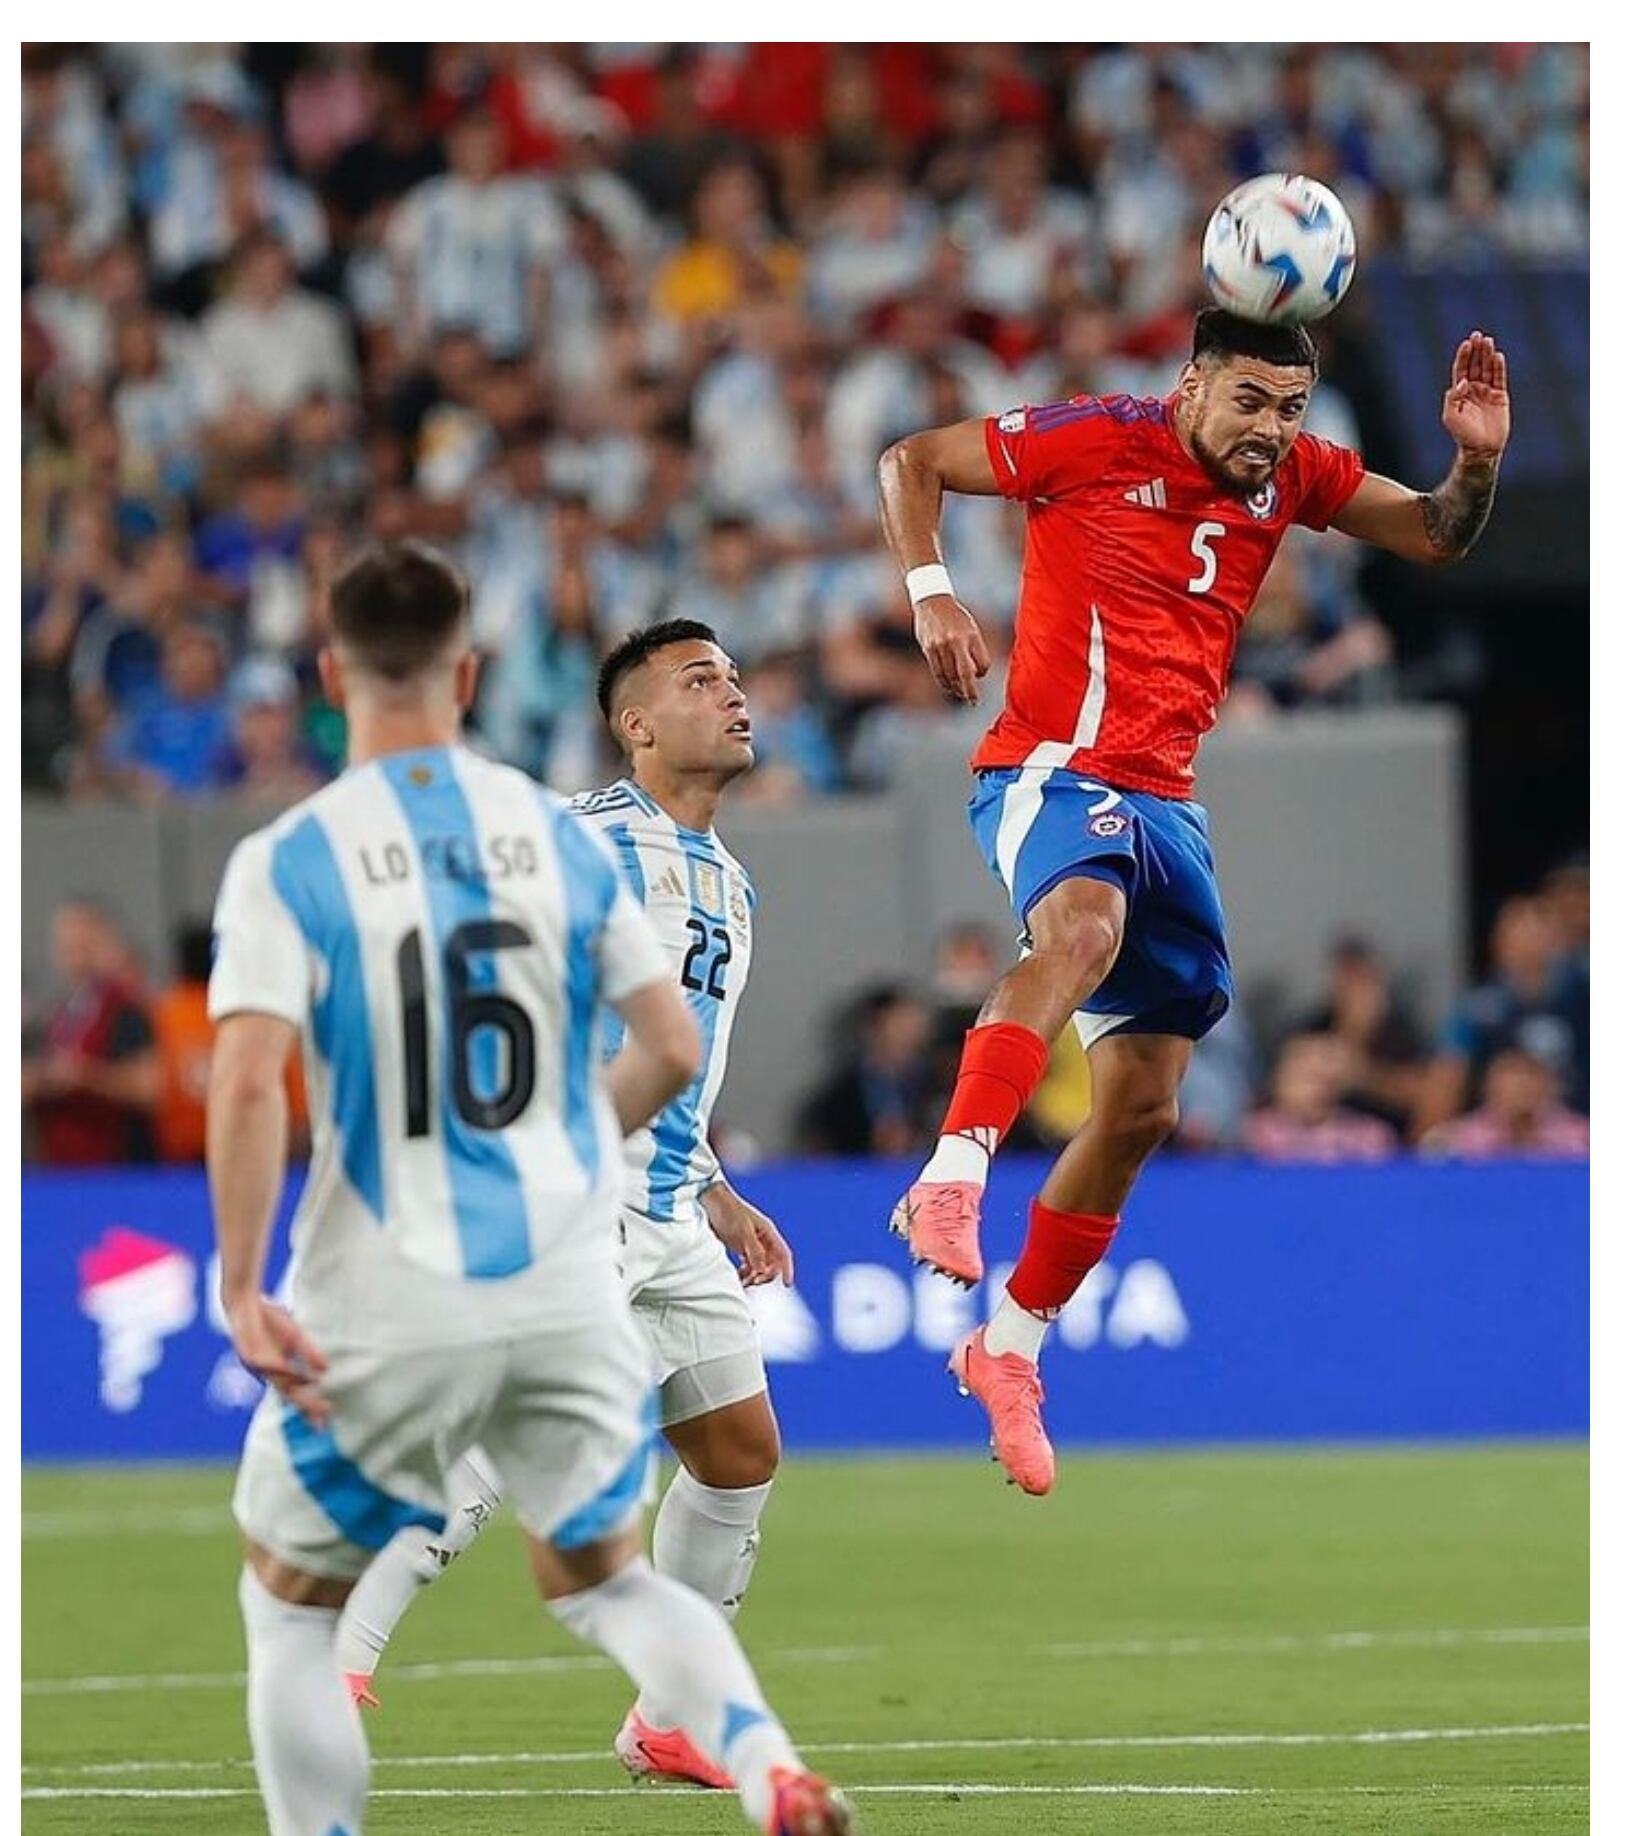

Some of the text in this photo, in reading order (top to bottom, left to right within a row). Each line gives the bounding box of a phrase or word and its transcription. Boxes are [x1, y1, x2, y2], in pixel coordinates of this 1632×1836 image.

[1187, 521, 1226, 594] 5
[359, 840, 410, 885] LO
[681, 918, 733, 1001] 22
[396, 919, 536, 1139] 16
